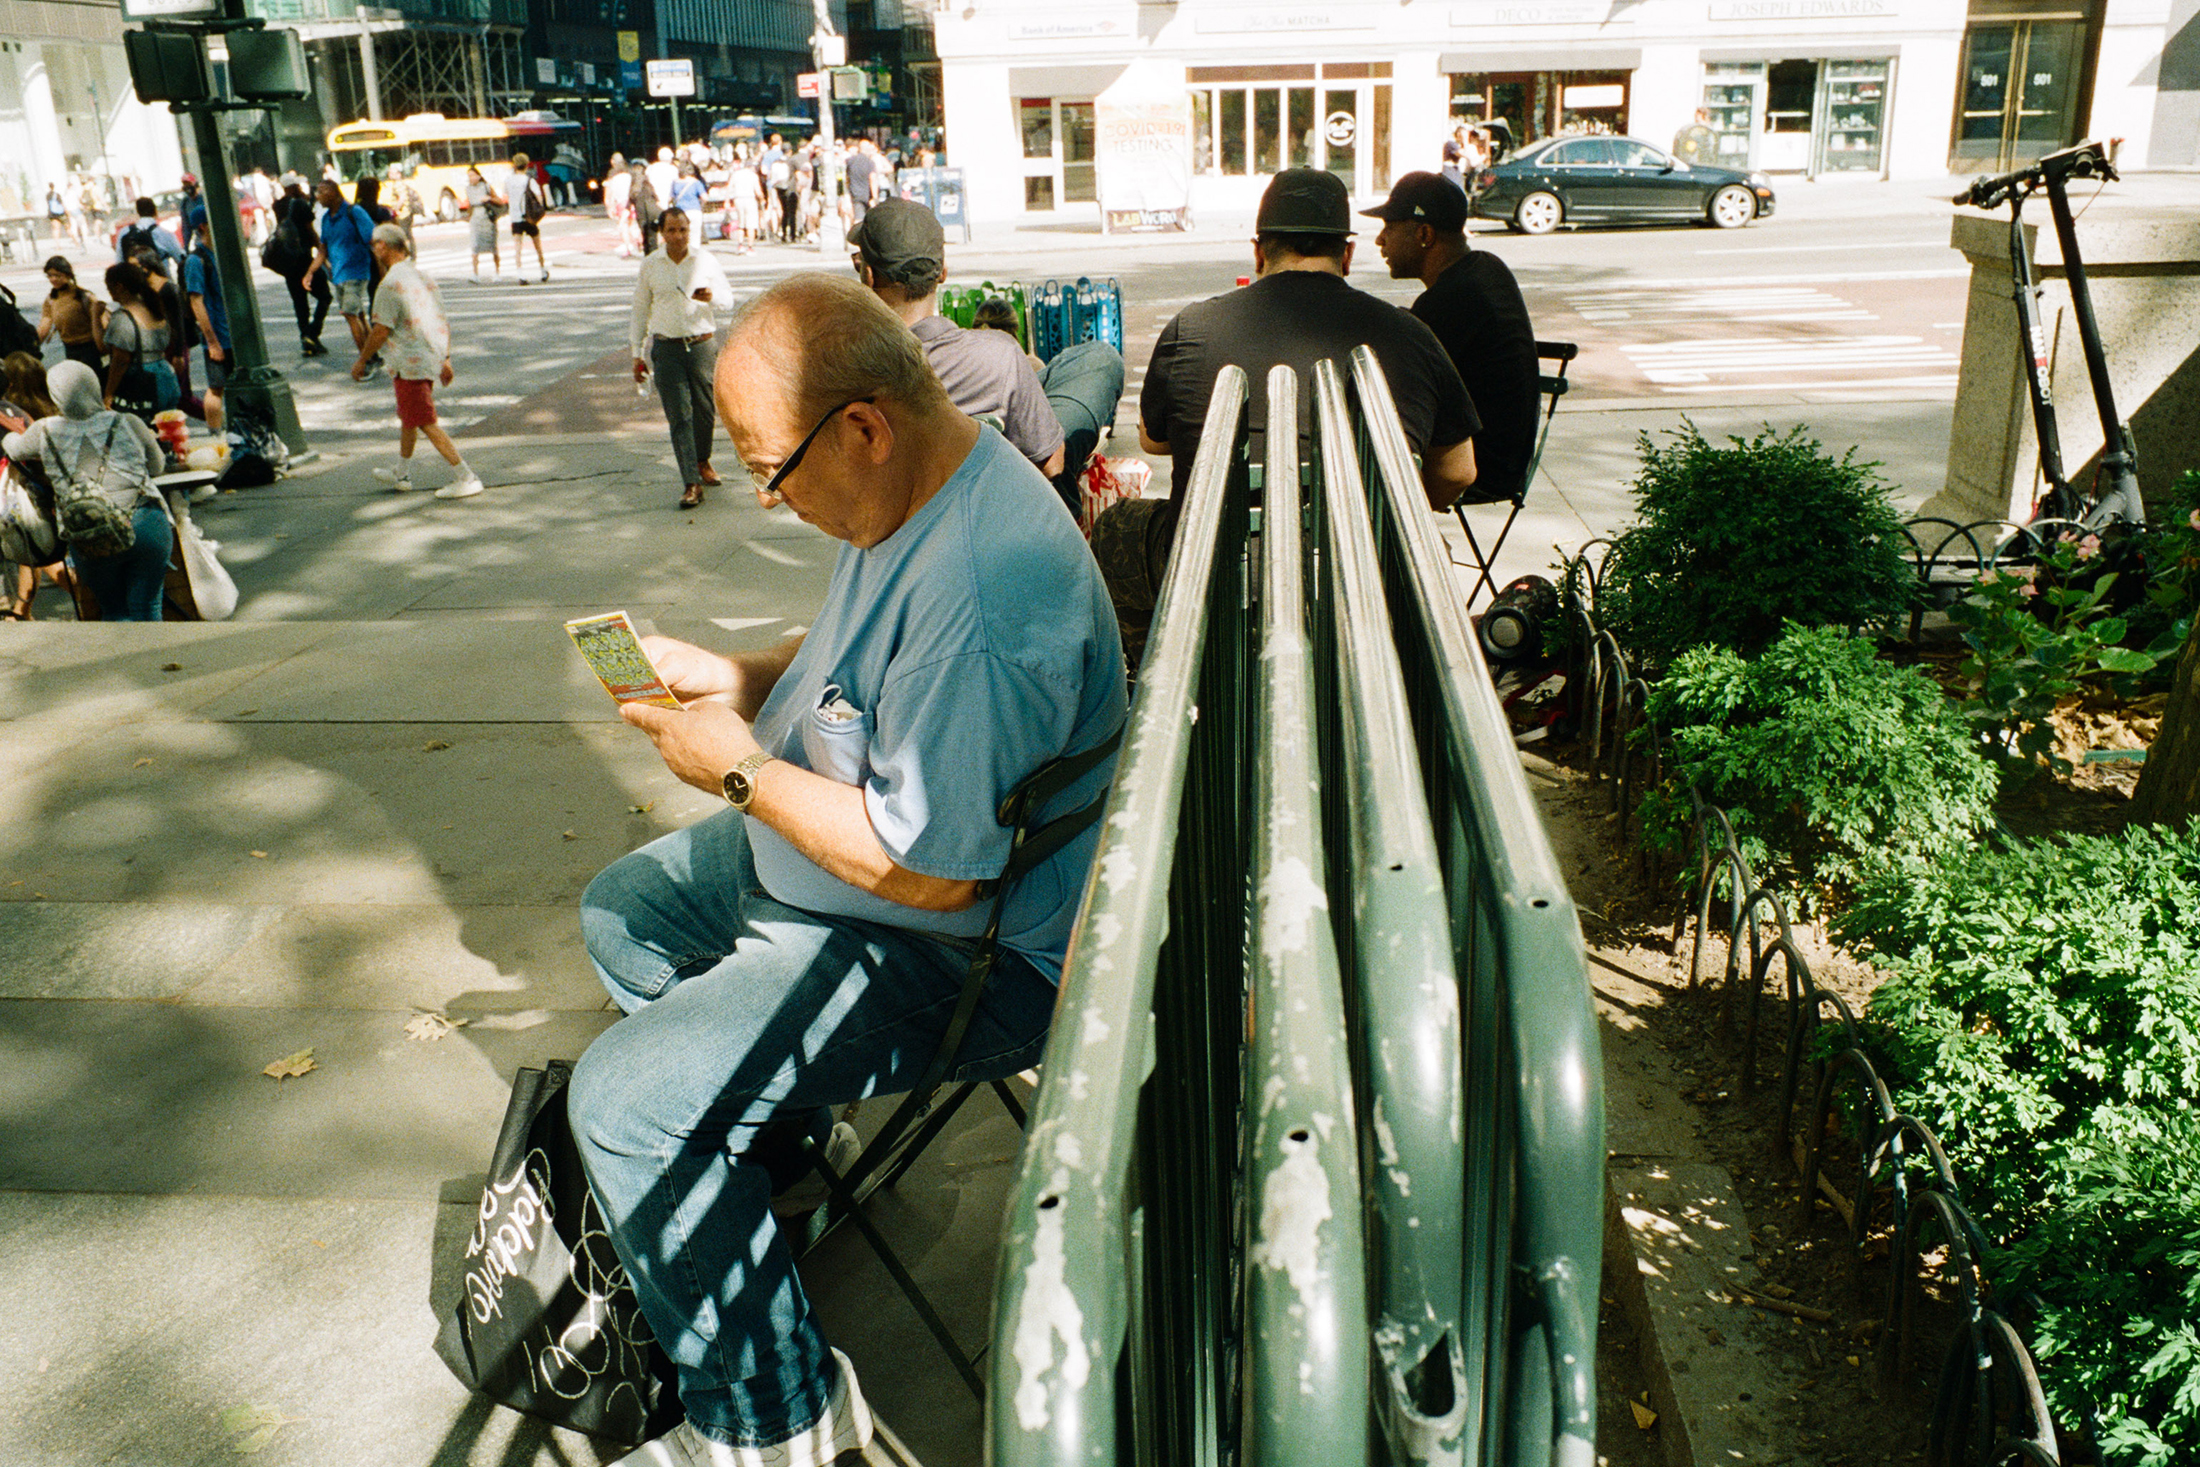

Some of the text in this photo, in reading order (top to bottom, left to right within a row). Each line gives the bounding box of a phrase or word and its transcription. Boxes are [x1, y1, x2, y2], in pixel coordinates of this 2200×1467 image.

[1494, 7, 1542, 22] DECO
[1729, 0, 1885, 18] JOSEPH EDWARDS
[1287, 15, 1331, 26] MATCHA
[1021, 24, 1093, 35] Bank of America
[1980, 73, 1999, 87] 501
[2033, 72, 2052, 86] 501
[1112, 138, 1174, 153] TESTING
[2029, 325, 2053, 406] NANROBOT
